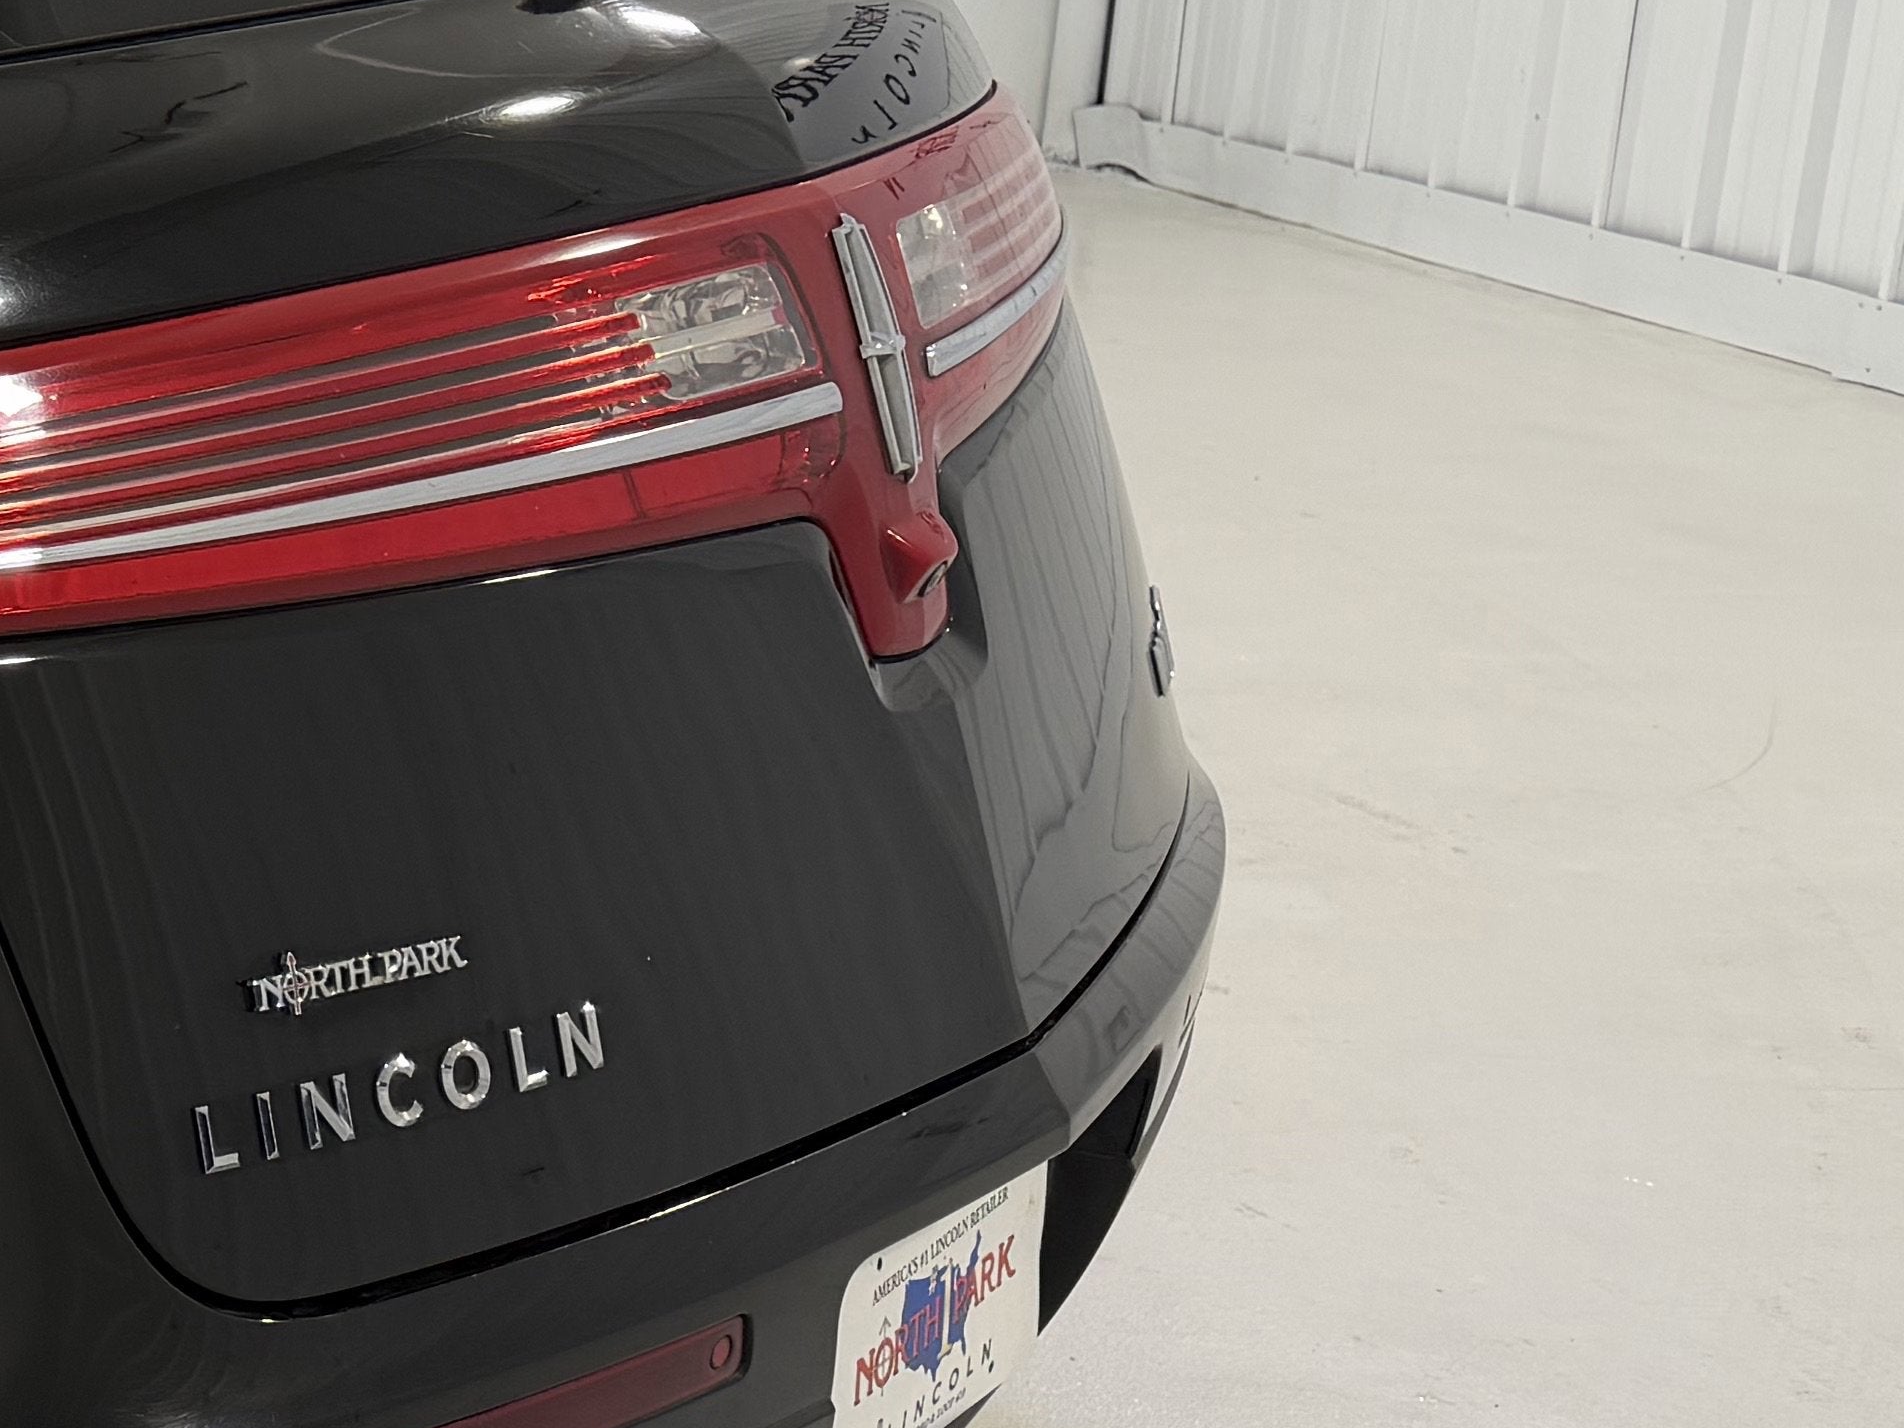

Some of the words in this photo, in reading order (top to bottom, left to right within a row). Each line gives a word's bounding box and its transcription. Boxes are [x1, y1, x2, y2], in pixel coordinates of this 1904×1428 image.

[253, 951, 374, 1015] NORTH
[378, 935, 469, 984] PARK
[194, 1000, 605, 1174] LINCOLN
[930, 1216, 969, 1260] LINCOLN
[970, 1186, 1009, 1229] RETAILER
[853, 1294, 942, 1406] NORTH
[954, 1233, 1017, 1324] PARK
